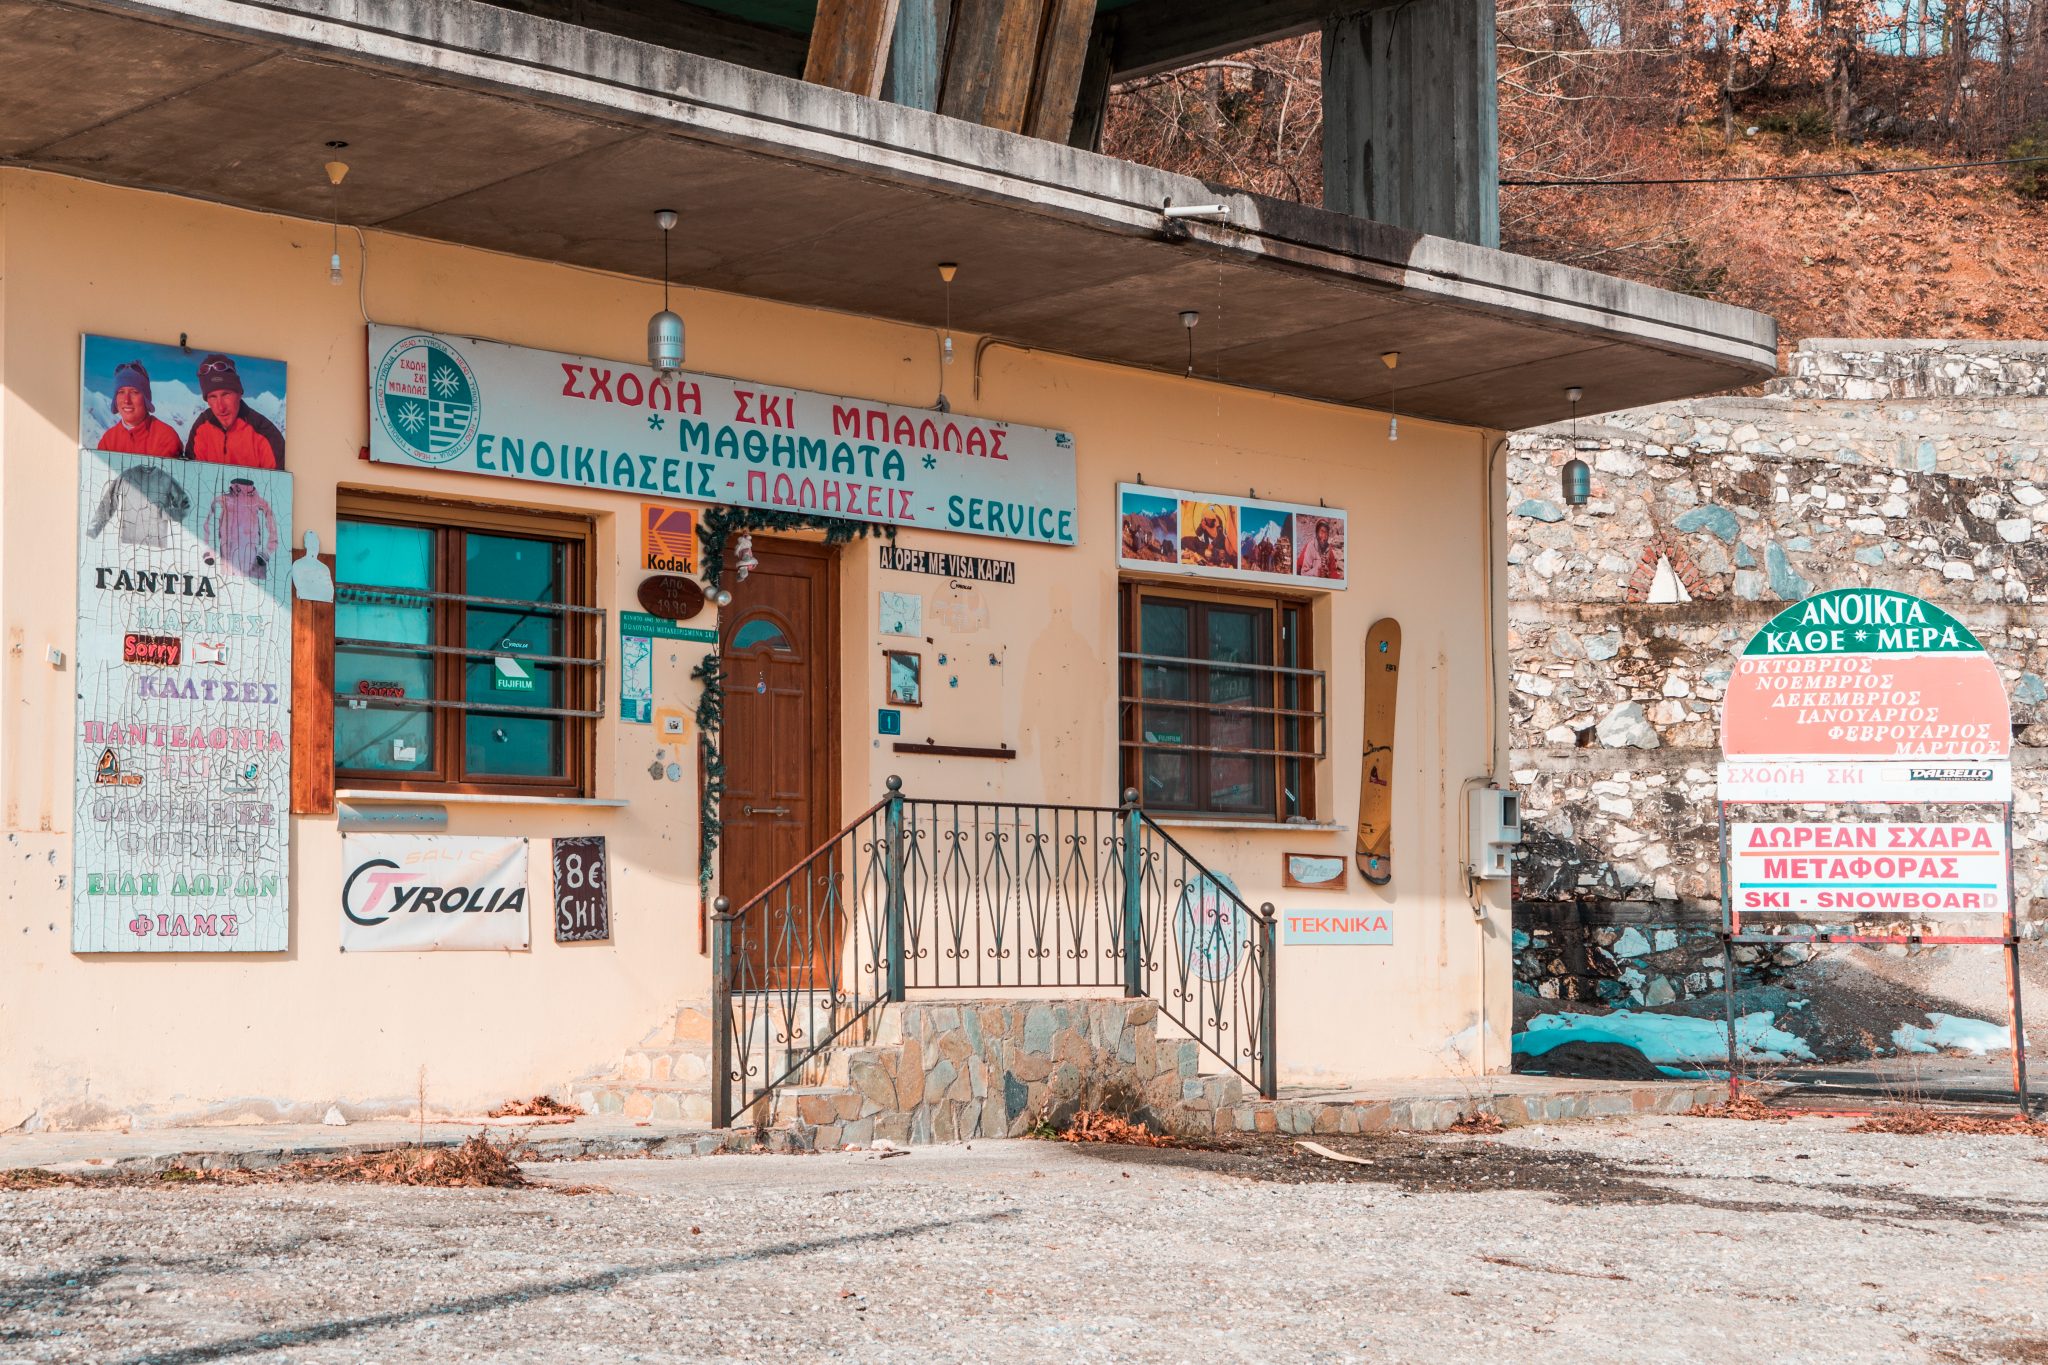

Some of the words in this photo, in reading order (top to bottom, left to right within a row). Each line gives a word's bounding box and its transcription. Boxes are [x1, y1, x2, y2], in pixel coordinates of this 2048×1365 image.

[400, 359, 426, 372] ΣΧΟΛΗ
[388, 381, 427, 395] ΜΠΑΛΛΑΣ
[414, 373, 427, 384] ΣΚΙ
[561, 363, 702, 415] ΣΧΟΛΗ
[733, 390, 795, 429] ΣΚΙ
[832, 404, 1009, 460] ΜΠΑΛΛΑΣ
[680, 418, 905, 481] ΜΑΘΗΜΑΤΑ
[476, 433, 717, 497] ΕΝΟΙΚΙΑΣΕΙΣ
[747, 470, 915, 520] ΠΩΛΗΣΕΙΣ
[948, 495, 1073, 541] SERVICE
[647, 554, 692, 573] Kodak
[929, 553, 946, 575] ΜΕ
[949, 555, 974, 578] VISA
[978, 558, 1014, 583] ΚΑΡΤΑ
[95, 567, 216, 597] ΓΑΝΤΙΑ
[657, 599, 687, 615] 1990
[1800, 594, 1926, 625] ΑΝΟΙΚΤΑ
[136, 606, 267, 637] ΜΑΣΚΕΣ
[125, 635, 179, 665] Sorry
[1767, 630, 1845, 654] ΚΑΘΕ
[1878, 626, 1960, 650] ΜΕΡΑ
[1740, 658, 1872, 674] ΟΚΤΩΒΡΙΟΣ
[138, 675, 279, 704] ΚΑΛΤΣΕΣ
[498, 679, 532, 689] FUJIFILM
[1756, 674, 1894, 690] ΝΟΕΜΒΡΙΟΣ
[1771, 691, 1920, 707] ΔΕΚΕΜΒΡΙΟΣ
[1797, 707, 1939, 724] ΙΑΝΟΥΑΡΙΟΣ
[83, 721, 285, 752] ΠΑΝΤΕΛΟΝΙΑ
[1828, 724, 1991, 741] ΦΕΒΡΟΥΑΡΙΟΣ
[1895, 740, 2001, 755] ΜΑΡΤΙΟΣ
[1727, 768, 1804, 784] ΣΧΟΛΗ
[1827, 768, 1864, 784] ΣΚΙ
[1912, 769, 1992, 778] DALBELLO
[1748, 827, 1876, 848] ΔΩΡΕΑΝ
[1887, 827, 1992, 848] ΣΧΑΡΑ
[1764, 857, 1959, 879] ΜΕΤΑΦΟΡΑΣ
[87, 872, 160, 897] ΕΙΔΗ
[170, 872, 278, 897] ΔΩΡΩΝ
[359, 872, 526, 913] TYROLIA
[1745, 891, 1790, 908] SKI
[1817, 891, 1998, 908] SNOWBOARD
[129, 914, 239, 937] ΦΙΛΜΣ
[1287, 916, 1388, 933] TEKNIKA
